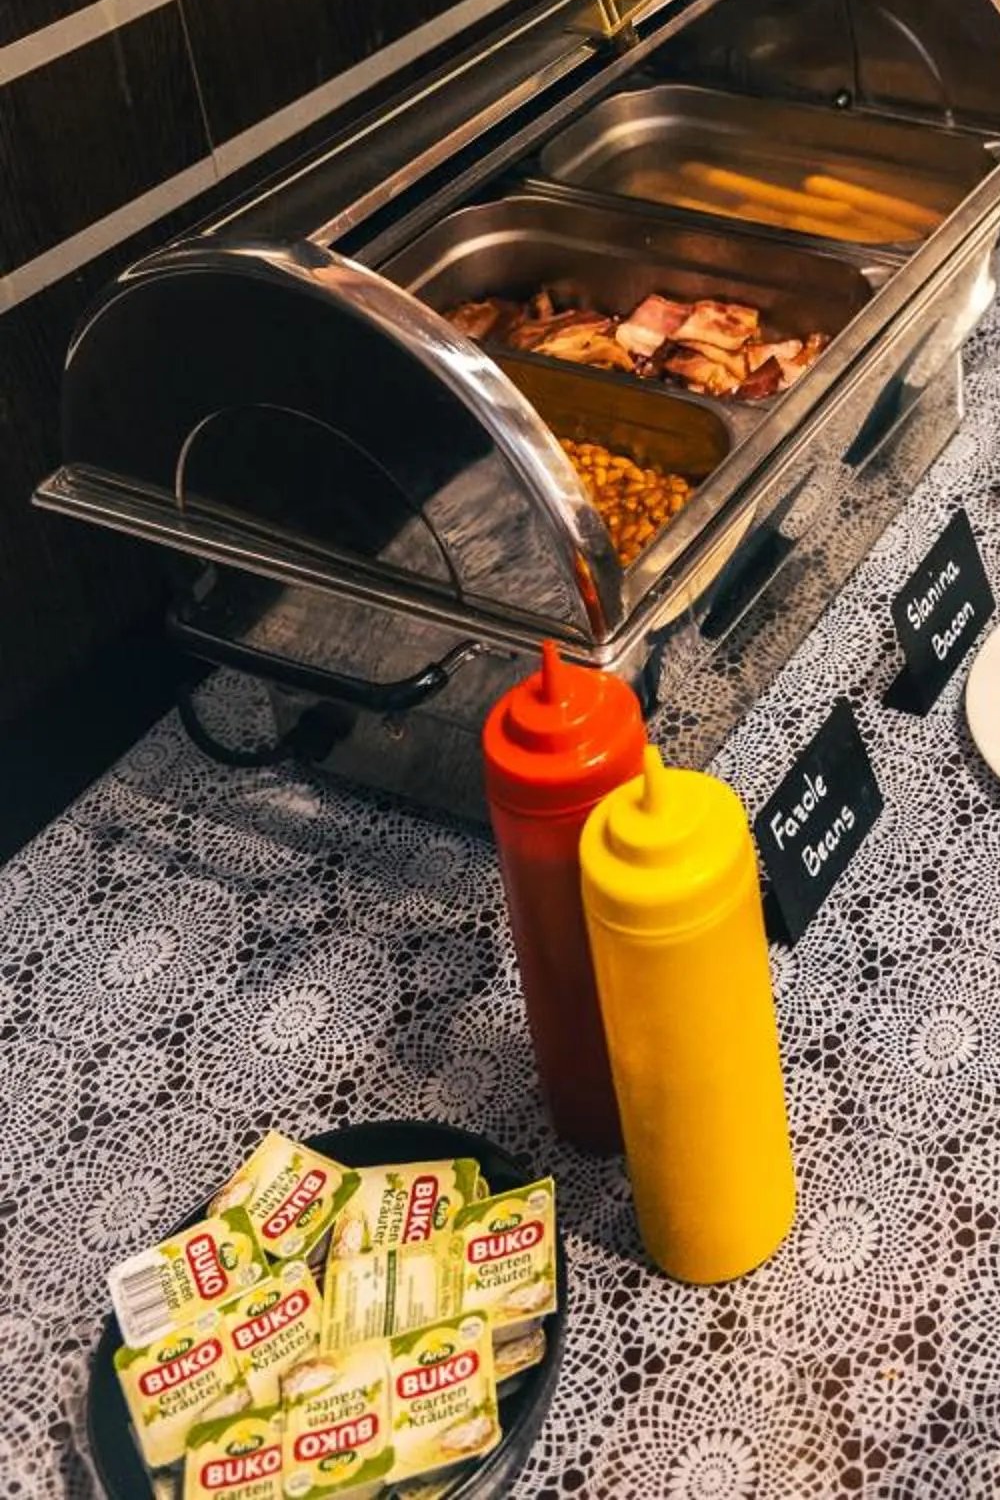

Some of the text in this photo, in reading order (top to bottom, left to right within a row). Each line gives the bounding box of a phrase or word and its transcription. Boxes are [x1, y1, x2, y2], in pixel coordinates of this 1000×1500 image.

[907, 560, 961, 631] Slanina
[931, 601, 975, 661] Bacon
[770, 772, 828, 851] Fazole
[801, 805, 855, 877] Beans
[268, 1175, 323, 1236] BUKO
[386, 1190, 409, 1244] Garten
[189, 1237, 225, 1297] BUKO
[471, 1225, 538, 1261] BUKO
[478, 1253, 532, 1278] Garten
[235, 1295, 305, 1347] BUKO
[251, 1321, 306, 1359] Garten
[144, 1343, 218, 1393] BUKO
[158, 1370, 216, 1405] Garten
[401, 1355, 474, 1396] BUKO
[409, 1385, 468, 1413] Garten
[300, 1419, 374, 1457] BUKO
[206, 1450, 281, 1487] BUKO
